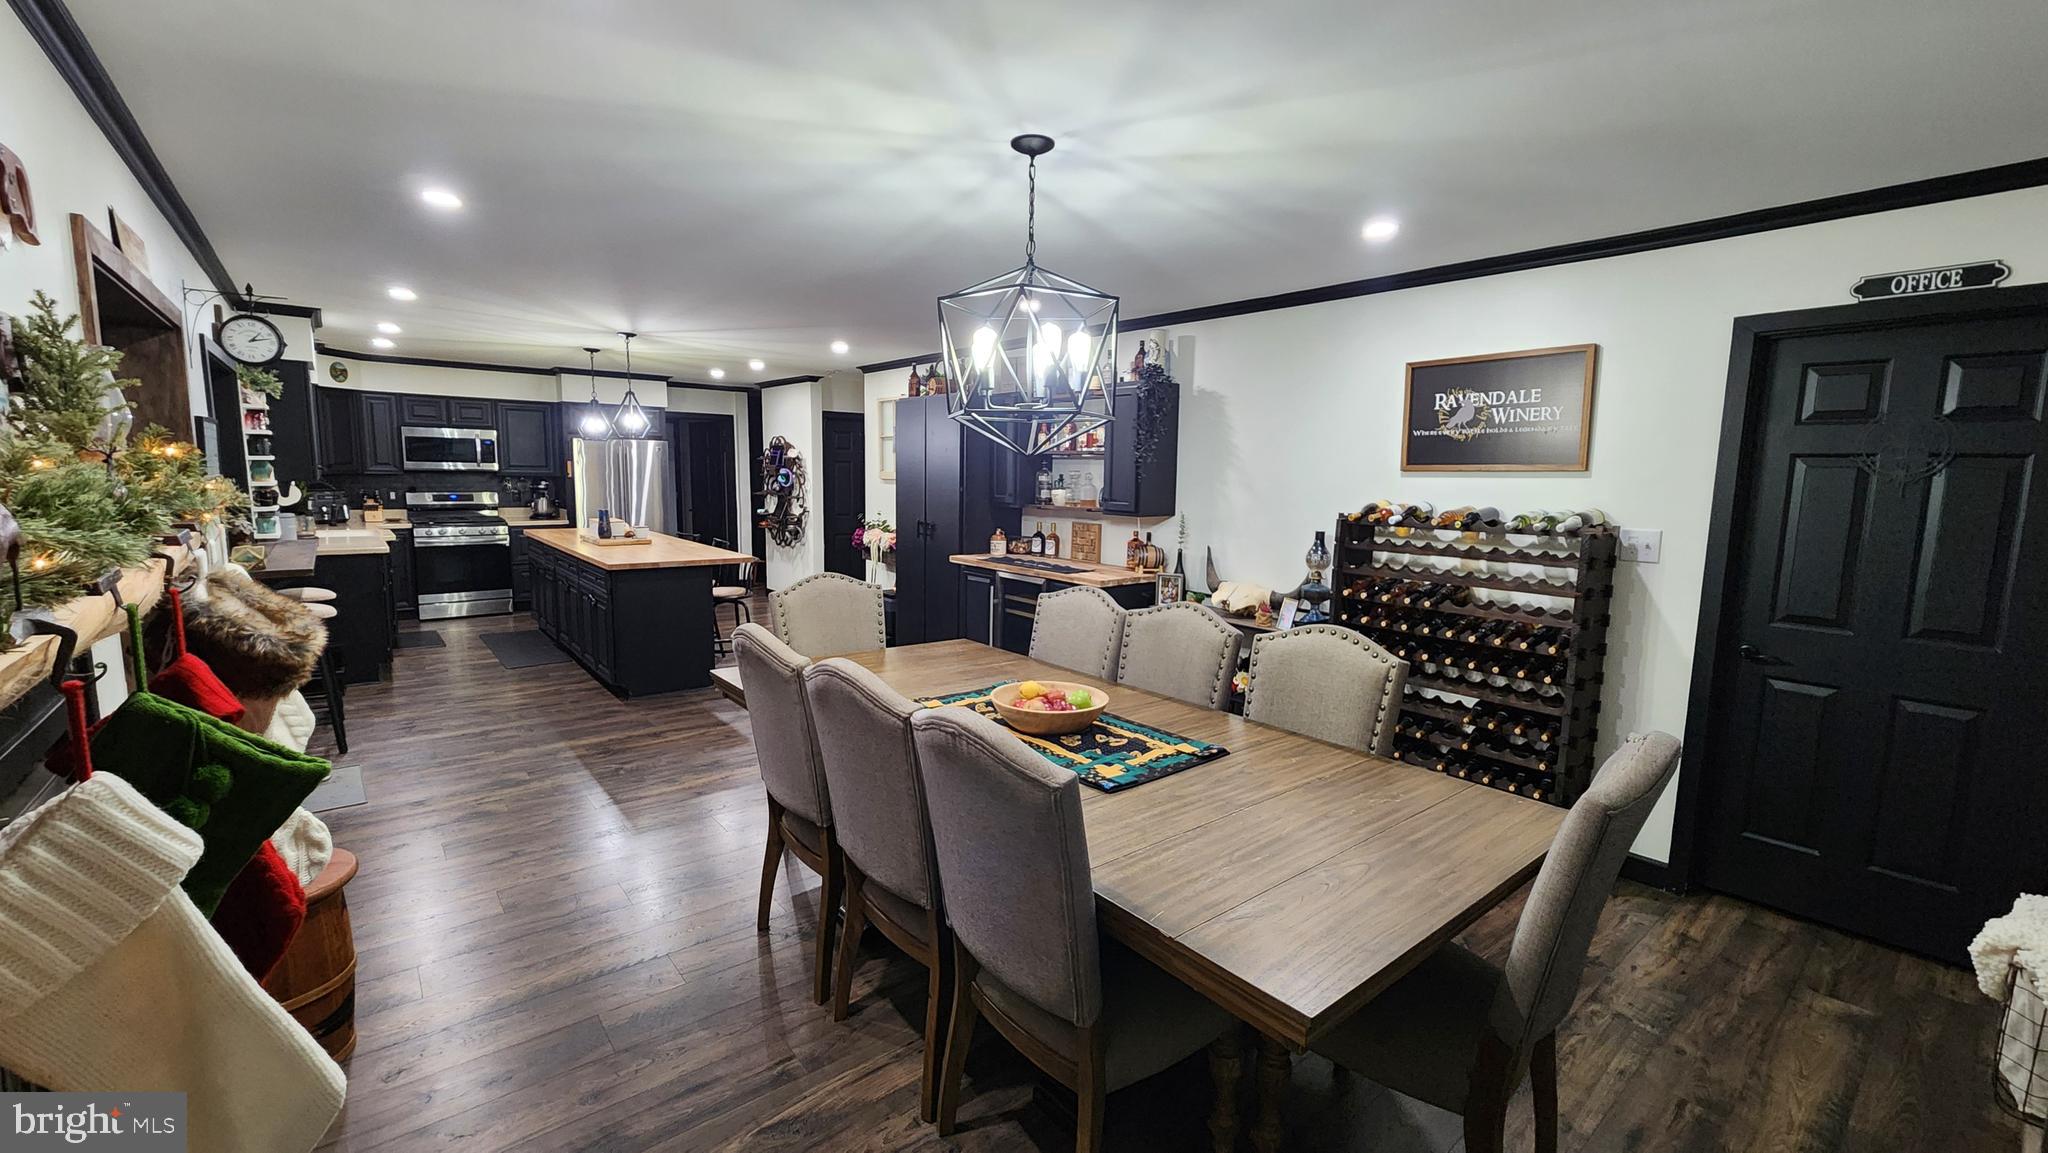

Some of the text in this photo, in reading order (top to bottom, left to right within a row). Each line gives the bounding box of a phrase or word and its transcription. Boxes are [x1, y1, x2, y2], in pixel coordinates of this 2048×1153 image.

[1890, 268, 1964, 294] OFFICE
[1433, 388, 1542, 411] RAVENDALE
[1490, 406, 1564, 425] WINERY
